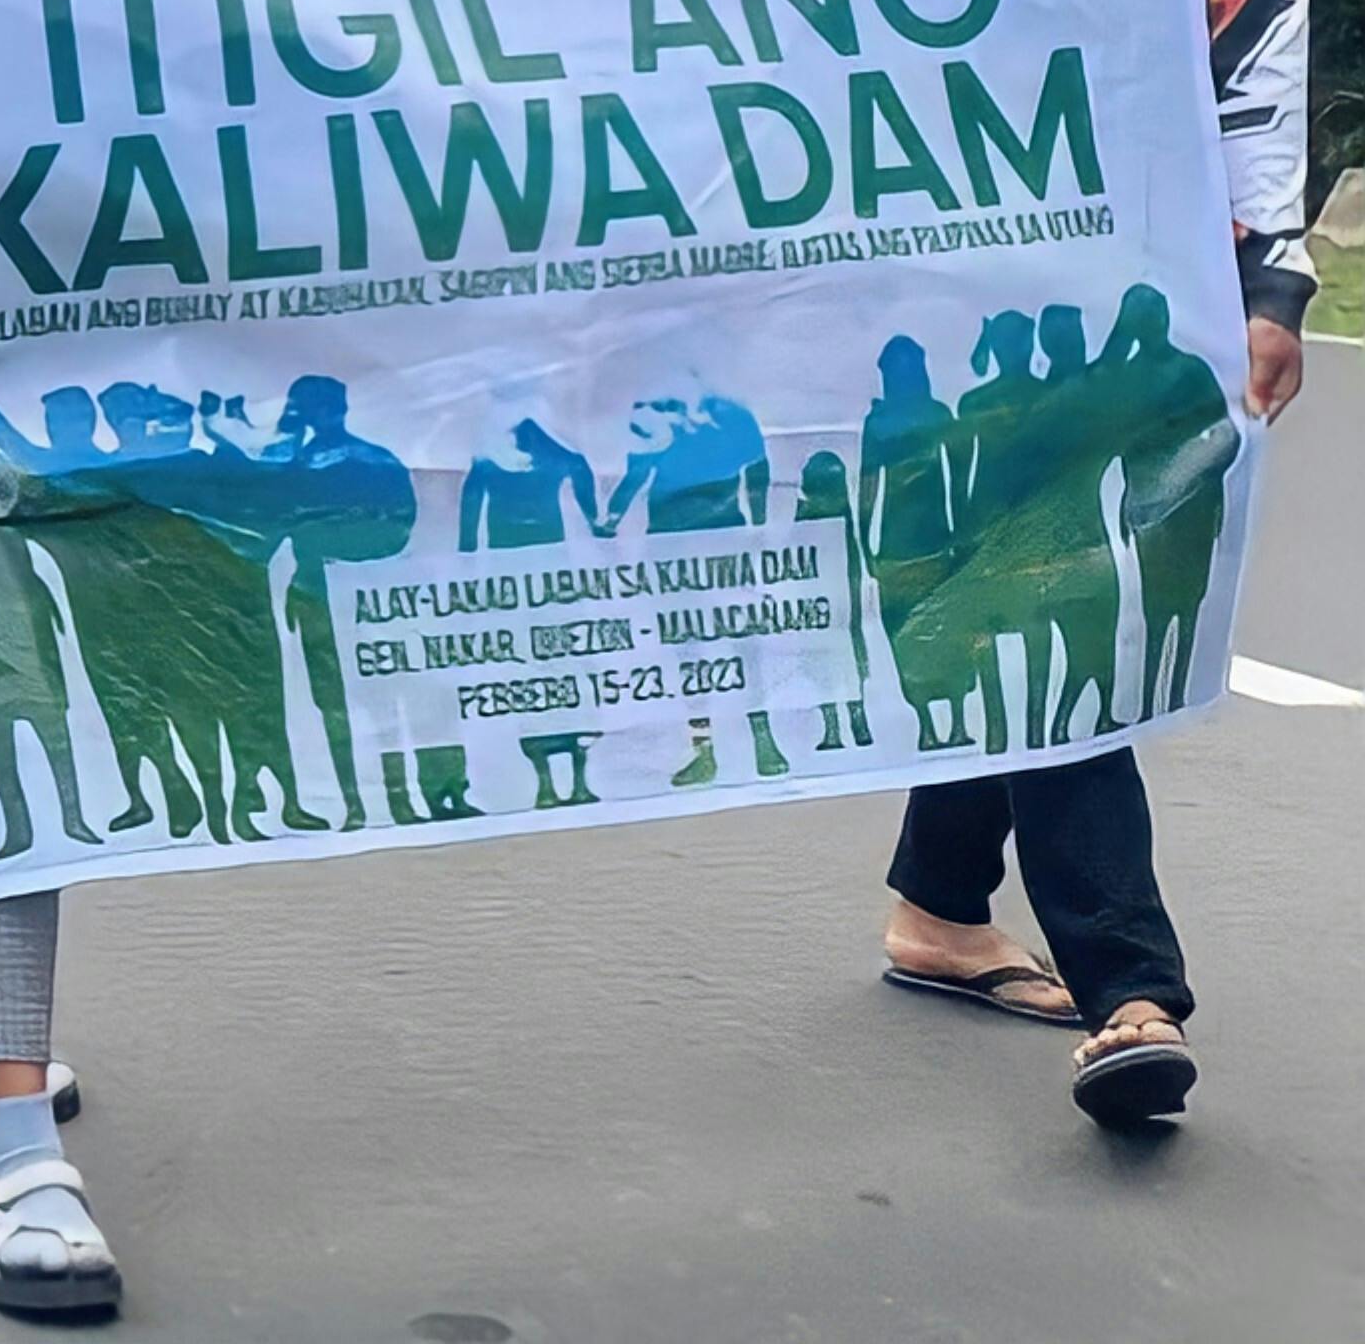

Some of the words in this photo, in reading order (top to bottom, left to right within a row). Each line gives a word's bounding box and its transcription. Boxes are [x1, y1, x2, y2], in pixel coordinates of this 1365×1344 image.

[707, 47, 1106, 229] DAM
[86, 298, 142, 331] ANG
[239, 287, 271, 319] AT
[355, 575, 519, 623] ALAY-LAKAD
[524, 567, 612, 608] LABAN
[616, 561, 654, 598] SA
[654, 551, 757, 594] KALIWA
[760, 544, 819, 585] DAM
[679, 655, 746, 697] 2023
